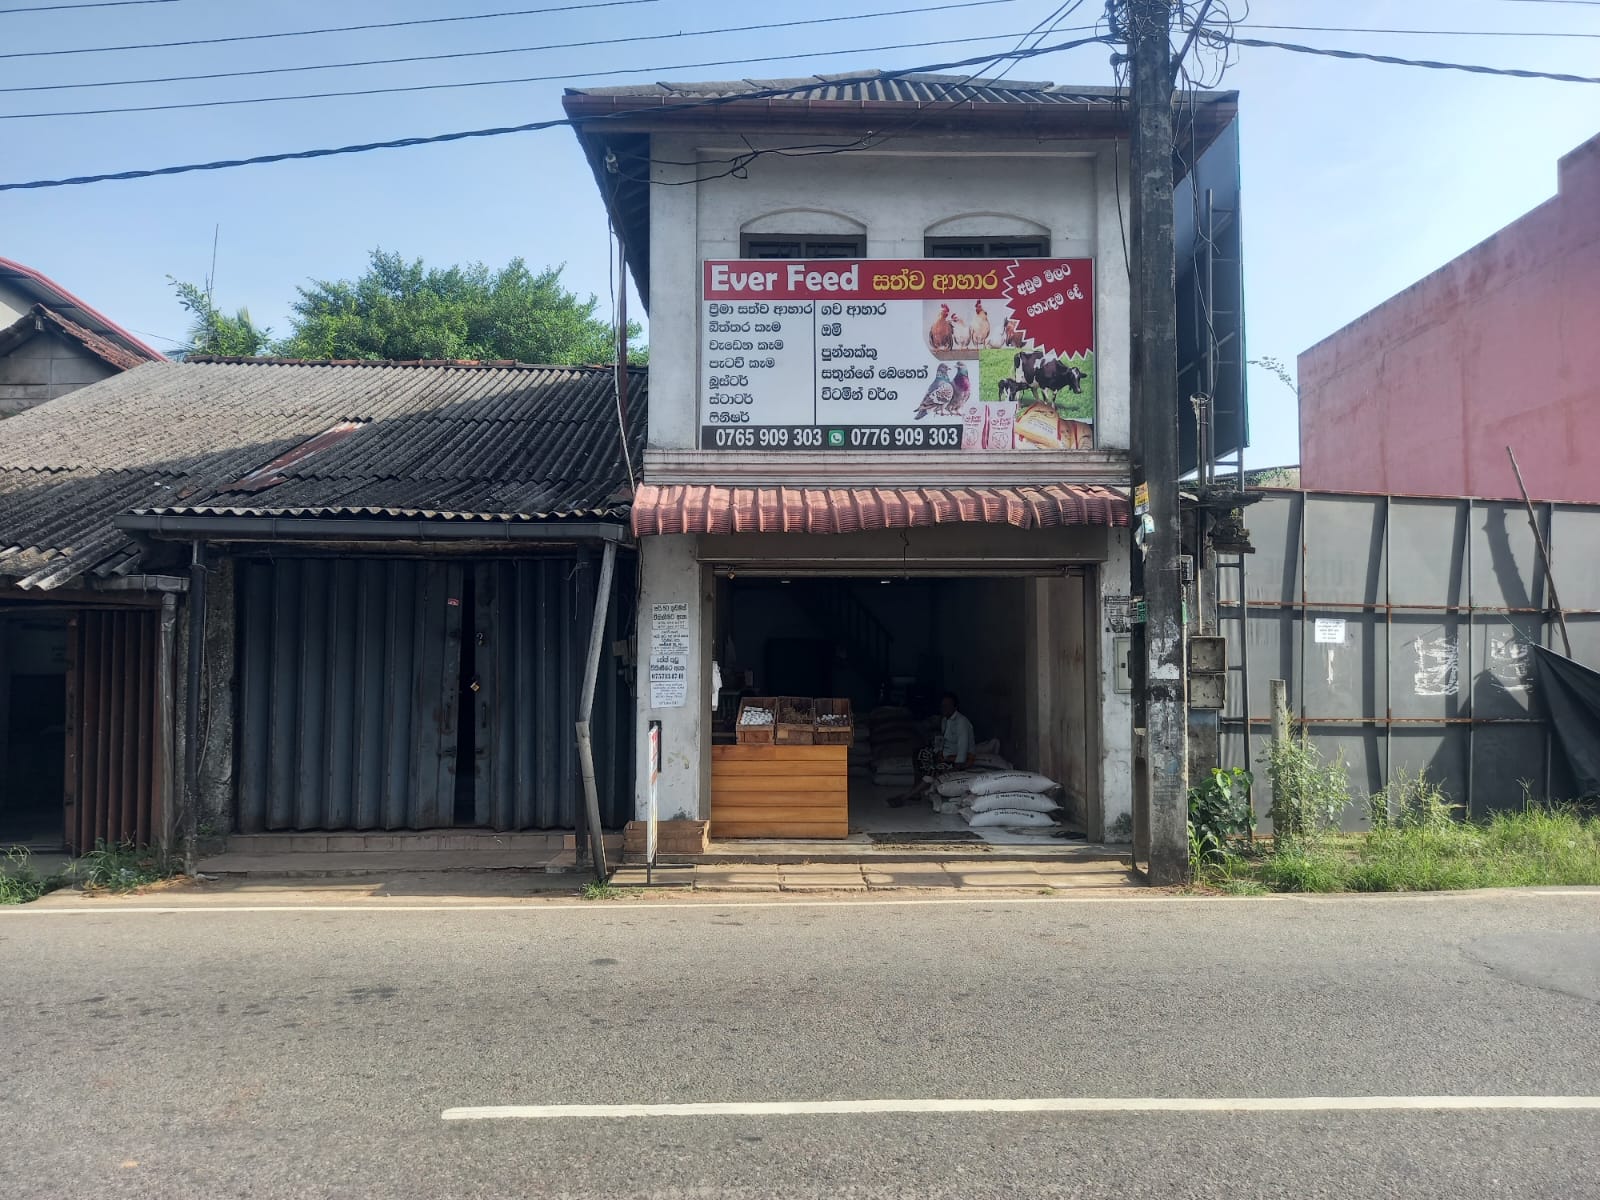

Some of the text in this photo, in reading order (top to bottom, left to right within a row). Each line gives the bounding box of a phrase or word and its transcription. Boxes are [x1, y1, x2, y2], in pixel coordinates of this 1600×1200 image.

[711, 263, 859, 292] Ever Feed
[872, 268, 999, 294] සත්ව ආහාර
[773, 303, 813, 316] ආහාර
[821, 302, 887, 319] ගව ආහාර
[708, 320, 751, 333] බිත්තර
[821, 365, 929, 382] සතුන්ගේ බෙහෙත්
[867, 386, 898, 401] වර්ග
[715, 428, 823, 447] 0765 909 303
[850, 427, 958, 446] 0776 909 303
